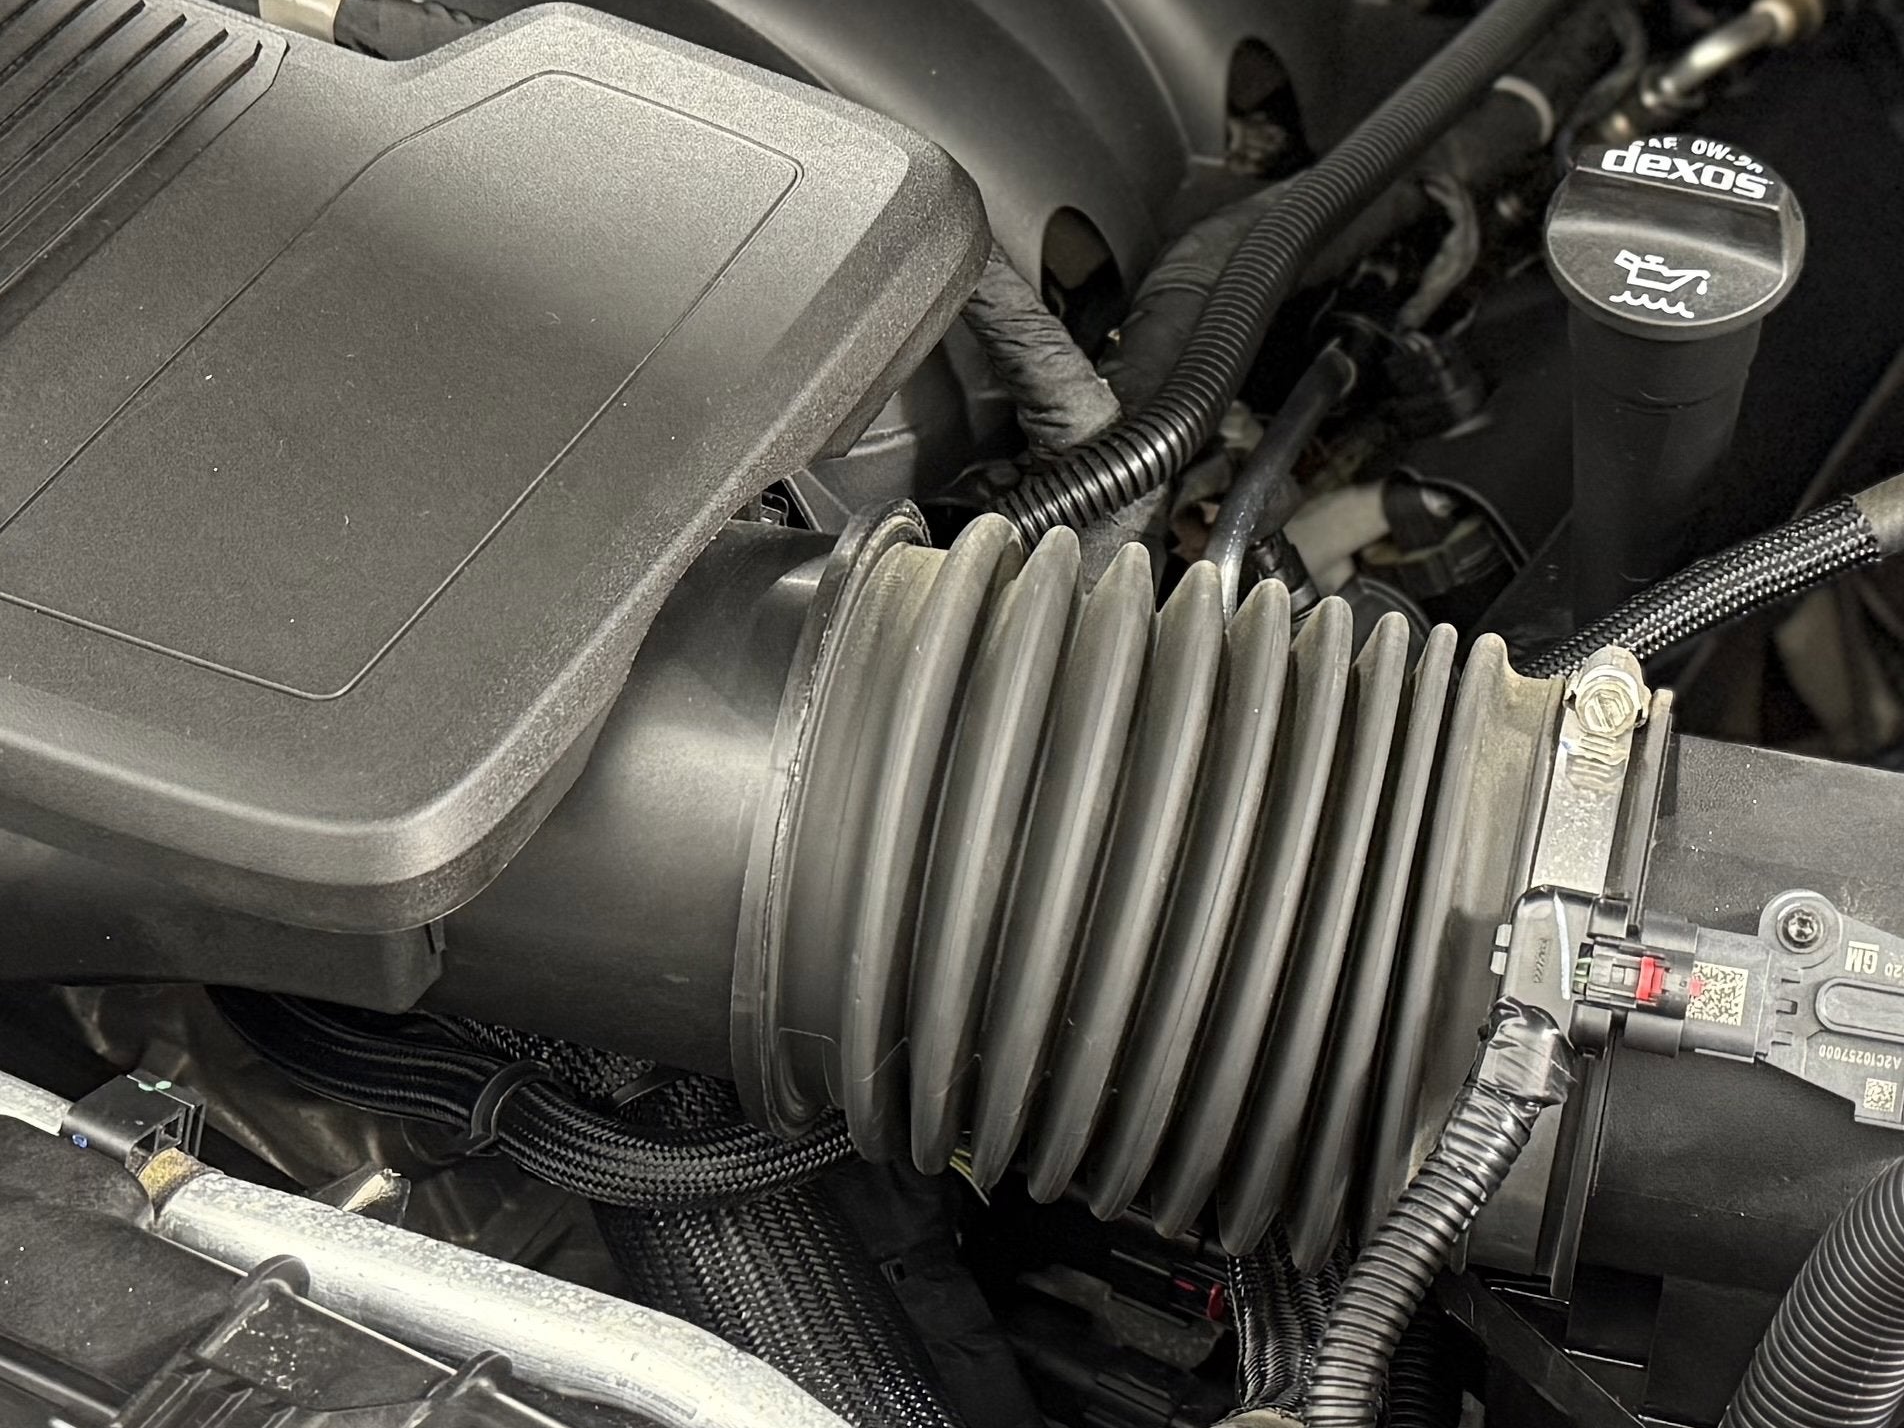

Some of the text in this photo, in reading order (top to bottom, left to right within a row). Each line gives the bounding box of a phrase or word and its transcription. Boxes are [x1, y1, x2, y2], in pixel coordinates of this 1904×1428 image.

[1601, 143, 1769, 199] dexos
[1845, 945, 1879, 974] GM
[1818, 1044, 1902, 1070] A2C10257000
